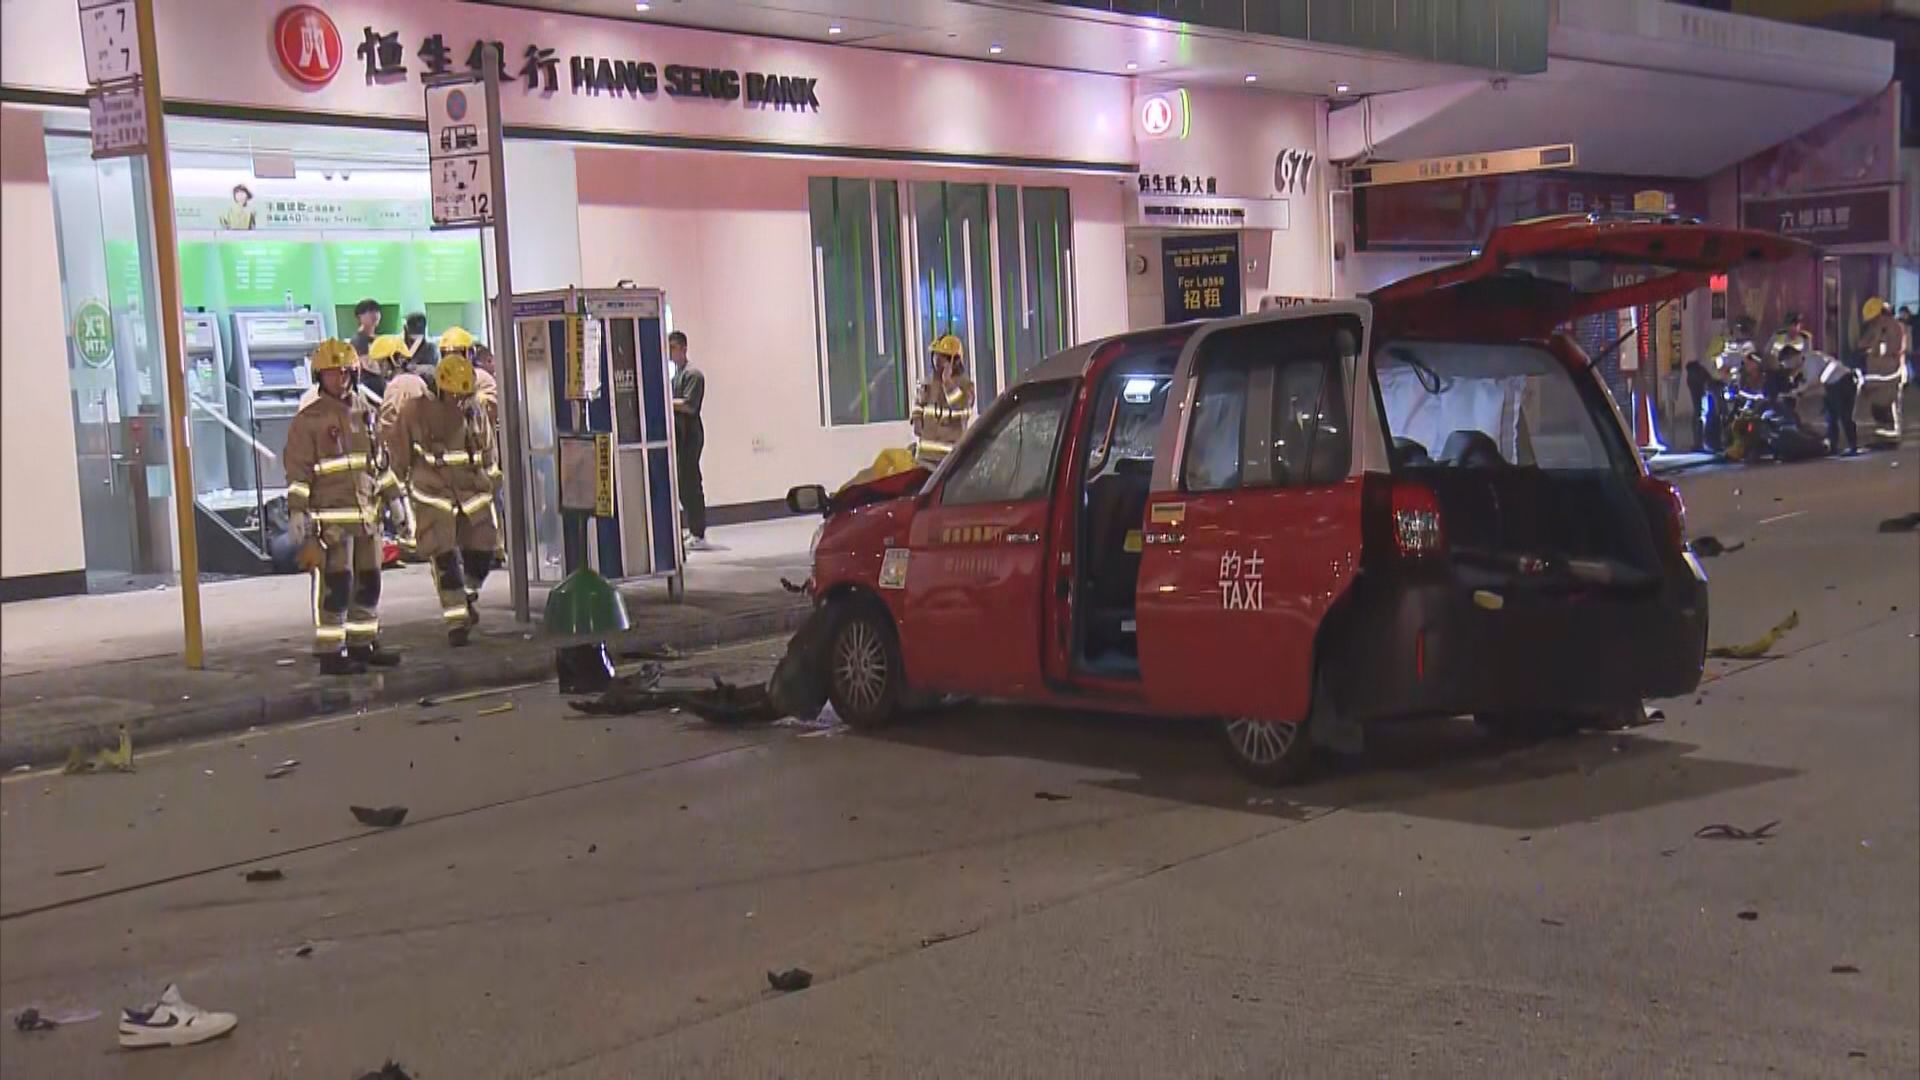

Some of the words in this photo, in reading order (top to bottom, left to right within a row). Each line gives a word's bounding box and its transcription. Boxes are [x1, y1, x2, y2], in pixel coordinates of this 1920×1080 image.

[117, 8, 125, 32] 7
[120, 48, 129, 72] 7
[570, 56, 657, 96] HANG
[664, 65, 740, 101] SENG
[744, 73, 819, 112] BANK
[468, 160, 478, 181] 7
[1274, 148, 1314, 194] 677
[471, 193, 489, 215] 12
[1178, 276, 1194, 289] For
[1196, 275, 1225, 288] Lease
[1183, 288, 1222, 310] 招租
[1220, 549, 1265, 579] 的士
[1219, 580, 1263, 611] TAXI
